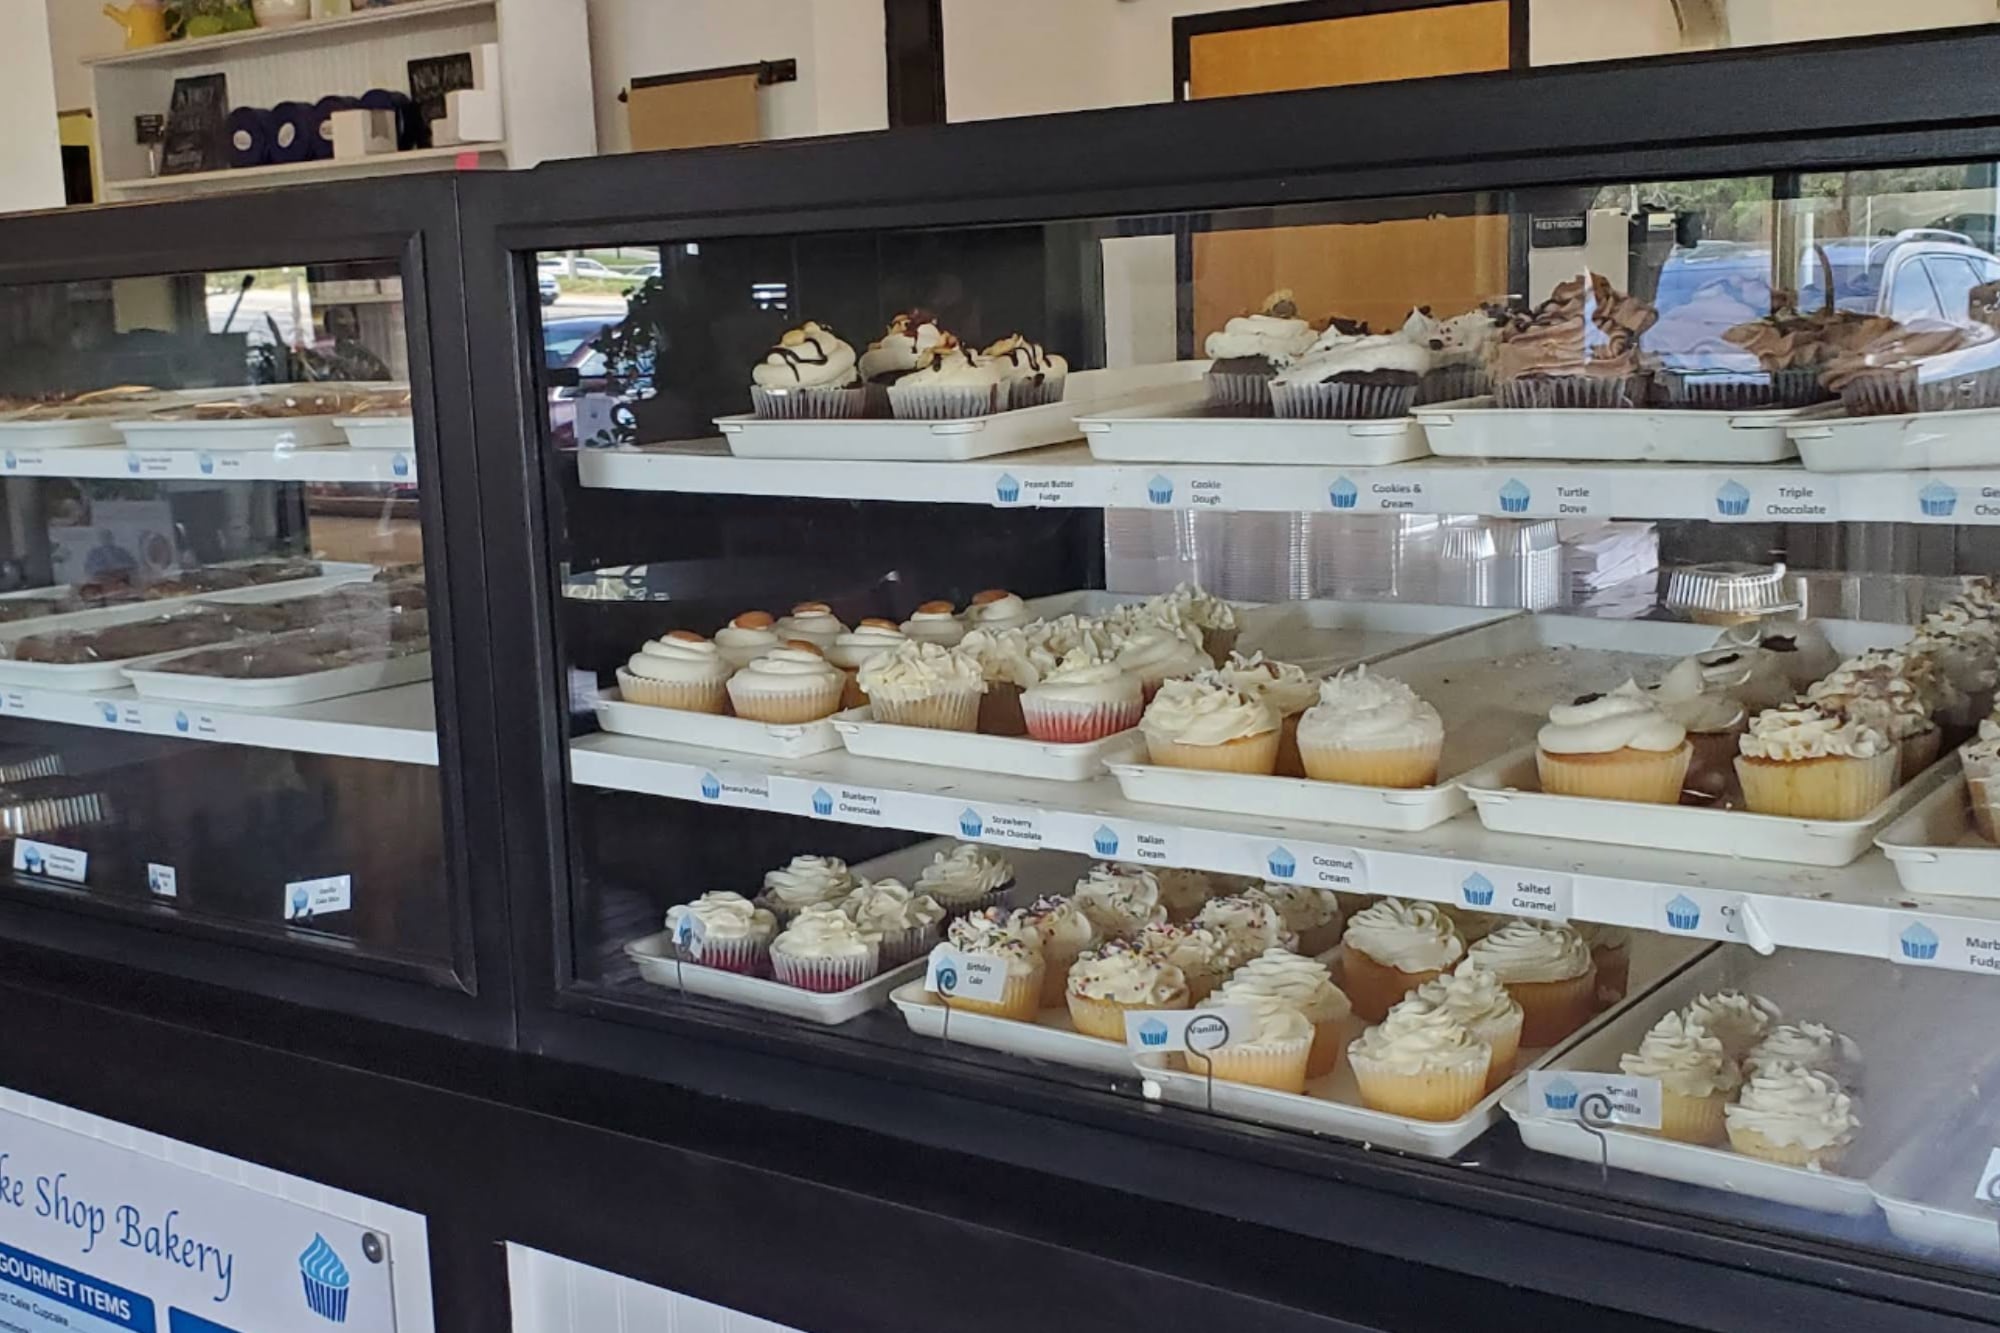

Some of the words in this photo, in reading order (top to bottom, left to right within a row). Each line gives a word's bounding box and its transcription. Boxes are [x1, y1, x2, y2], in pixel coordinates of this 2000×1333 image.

[1051, 480, 1074, 488] Butter
[1191, 480, 1222, 489] Cookie
[1372, 483, 1412, 494] Cookies
[1413, 484, 1422, 493] &
[1038, 492, 1061, 501] Fudge
[1557, 487, 1590, 498] Turtle
[1778, 487, 1814, 500] Triple
[1191, 494, 1221, 504] Dough
[1381, 499, 1414, 509] Cream
[1559, 503, 1587, 513] Dove
[1766, 504, 1827, 515] Chocolate
[842, 791, 877, 803] Blueberry
[839, 803, 881, 816] Cheesecake
[992, 816, 1032, 828] Strawberry
[984, 827, 1005, 837] White
[1007, 828, 1042, 841] Chocolate
[1137, 835, 1165, 846] Italian
[1137, 848, 1166, 860] Cream
[1312, 856, 1353, 870] Coconut
[1318, 871, 1351, 885] Cream
[1517, 882, 1551, 896] Salted
[1512, 898, 1556, 912] Caramel
[1189, 1023, 1224, 1034] Vanilla
[35, 1173, 105, 1253] Shop
[115, 1205, 233, 1302] Bakery
[0, 1252, 76, 1299] GOURMET
[79, 1283, 132, 1322] ITEMS
[32, 1303, 69, 1327] Cupcake
